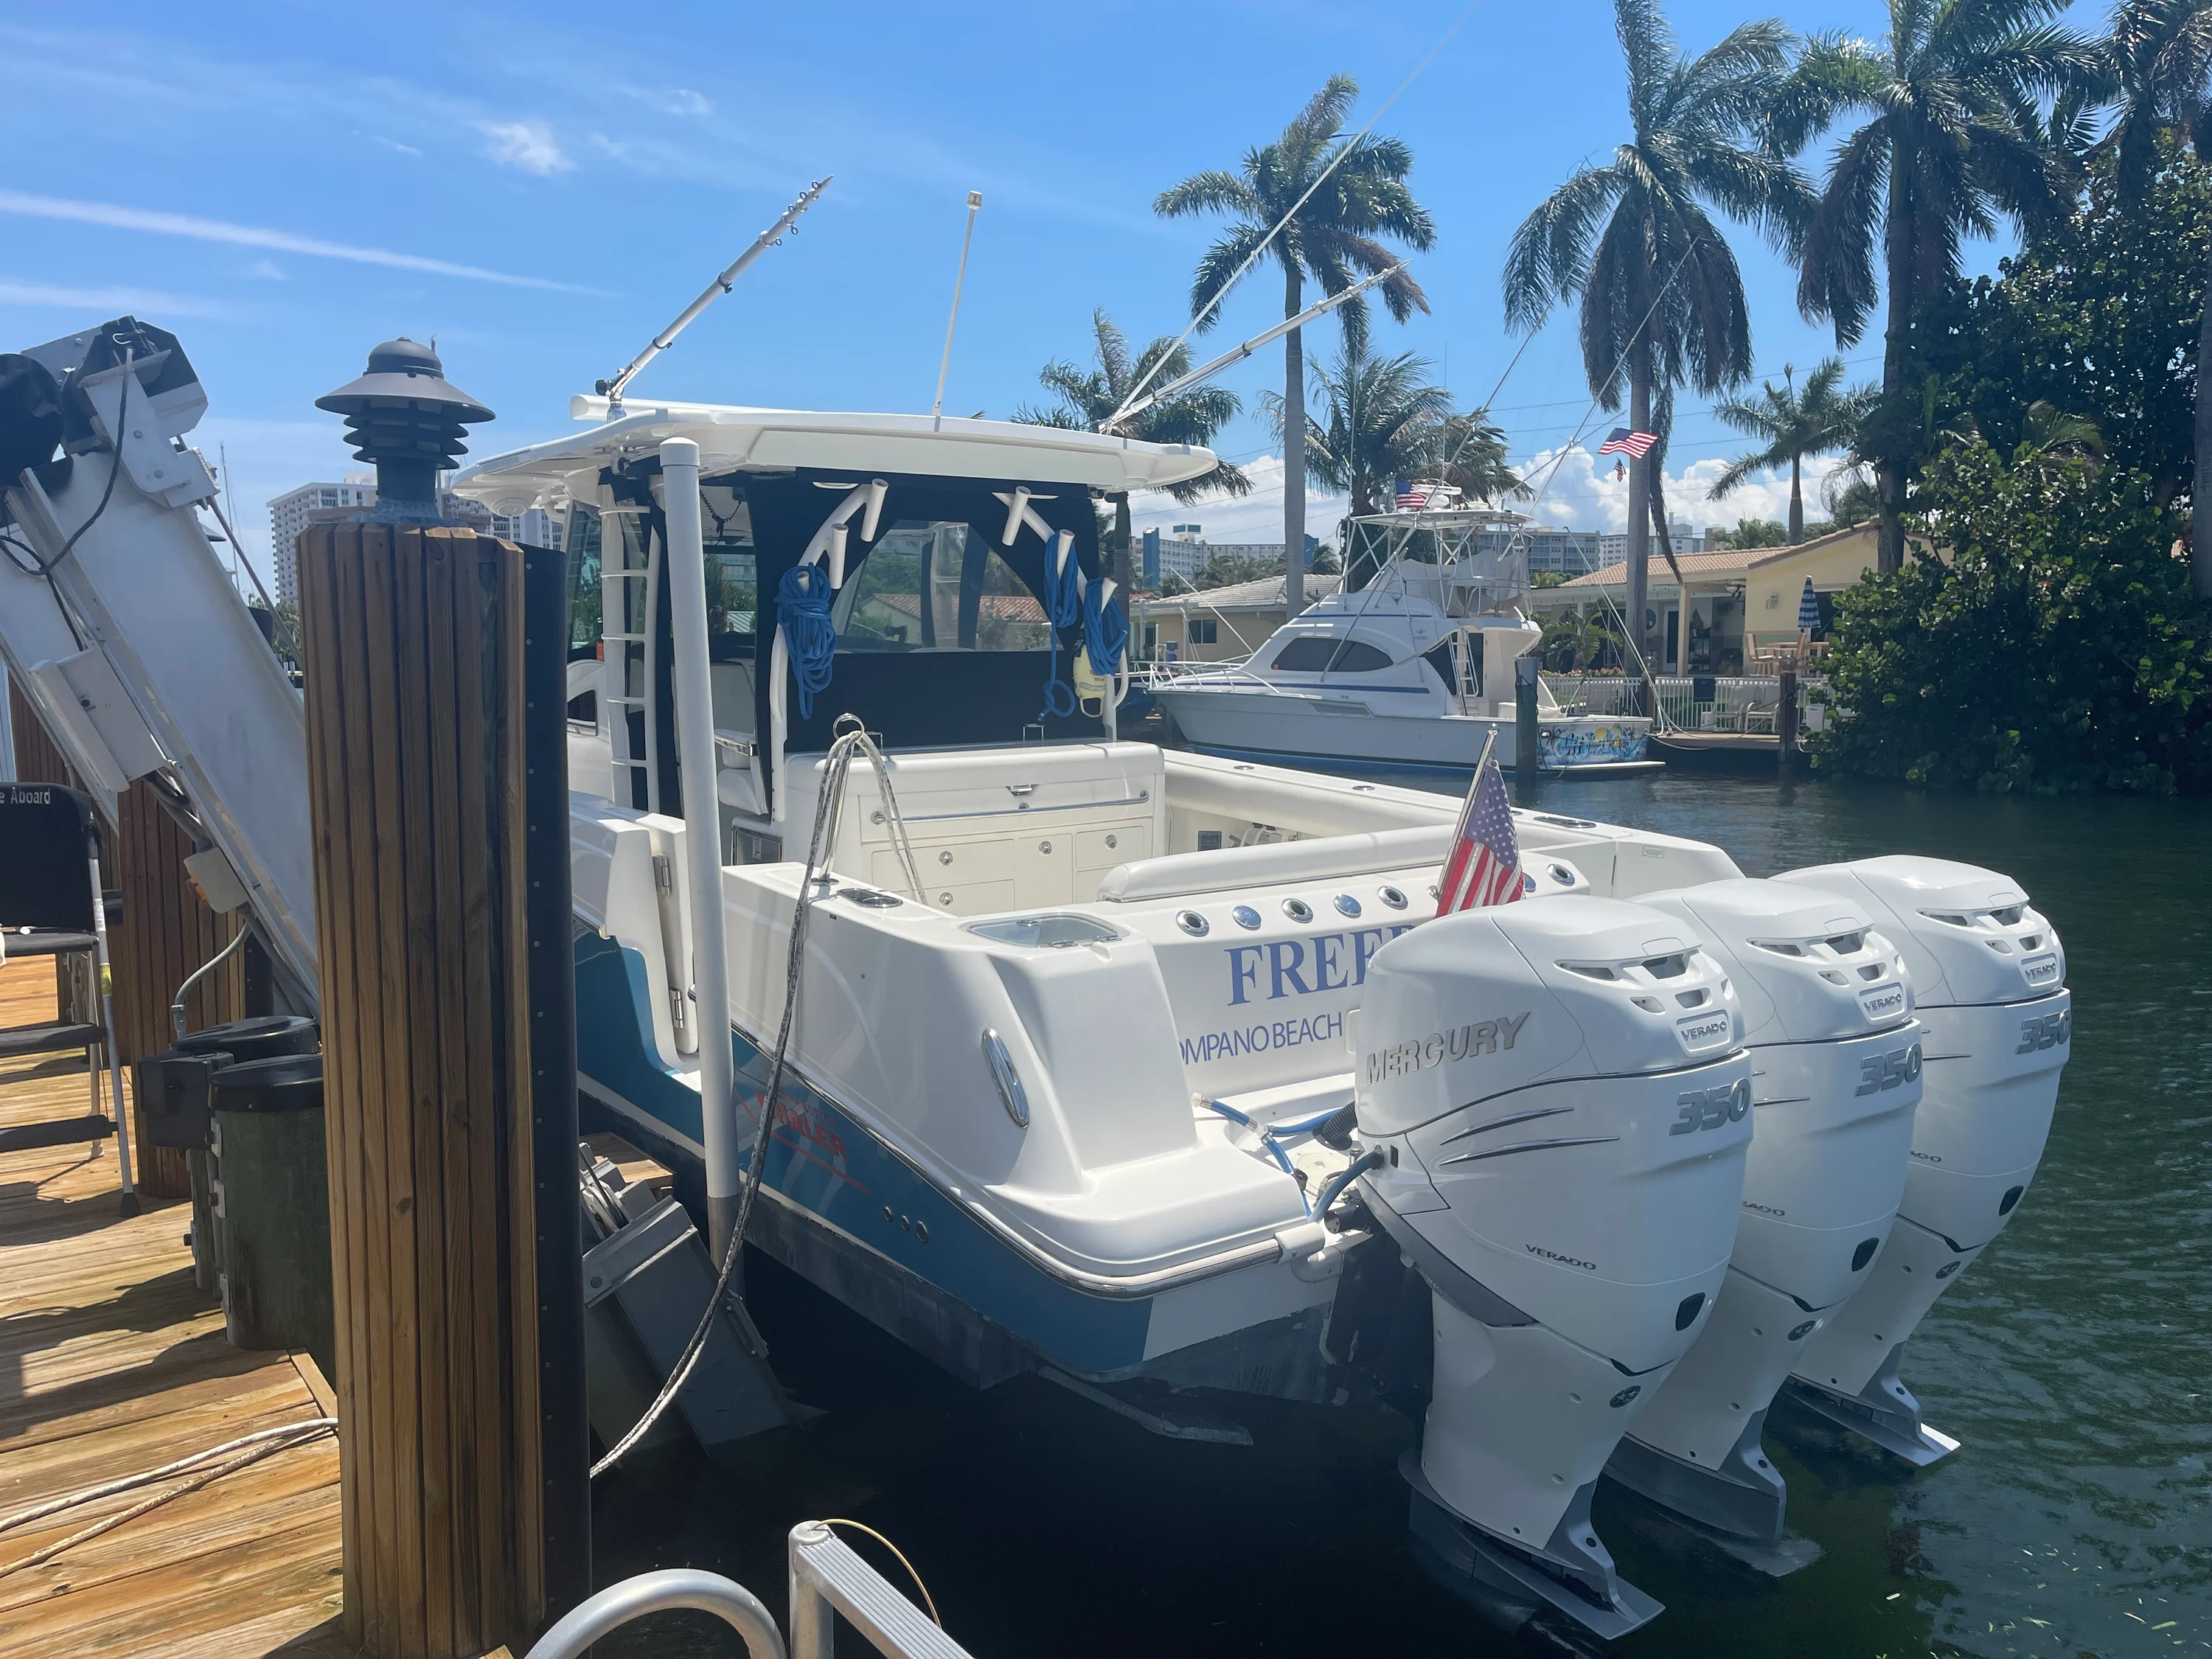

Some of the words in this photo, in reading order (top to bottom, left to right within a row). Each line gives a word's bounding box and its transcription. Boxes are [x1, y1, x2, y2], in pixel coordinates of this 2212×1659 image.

[10, 787, 51, 804] Aboard
[1223, 924, 1417, 1006] FREE
[1863, 993, 1902, 1012] VERADO
[1272, 1012, 1343, 1049] BEACH
[1366, 1011, 1532, 1085] MERCURY
[1680, 1020, 1727, 1041] VERADO
[2014, 1009, 2072, 1056] 350
[1854, 1043, 1922, 1098] 350
[1669, 1078, 1751, 1136] 350
[1525, 1243, 1596, 1270] VERADO
